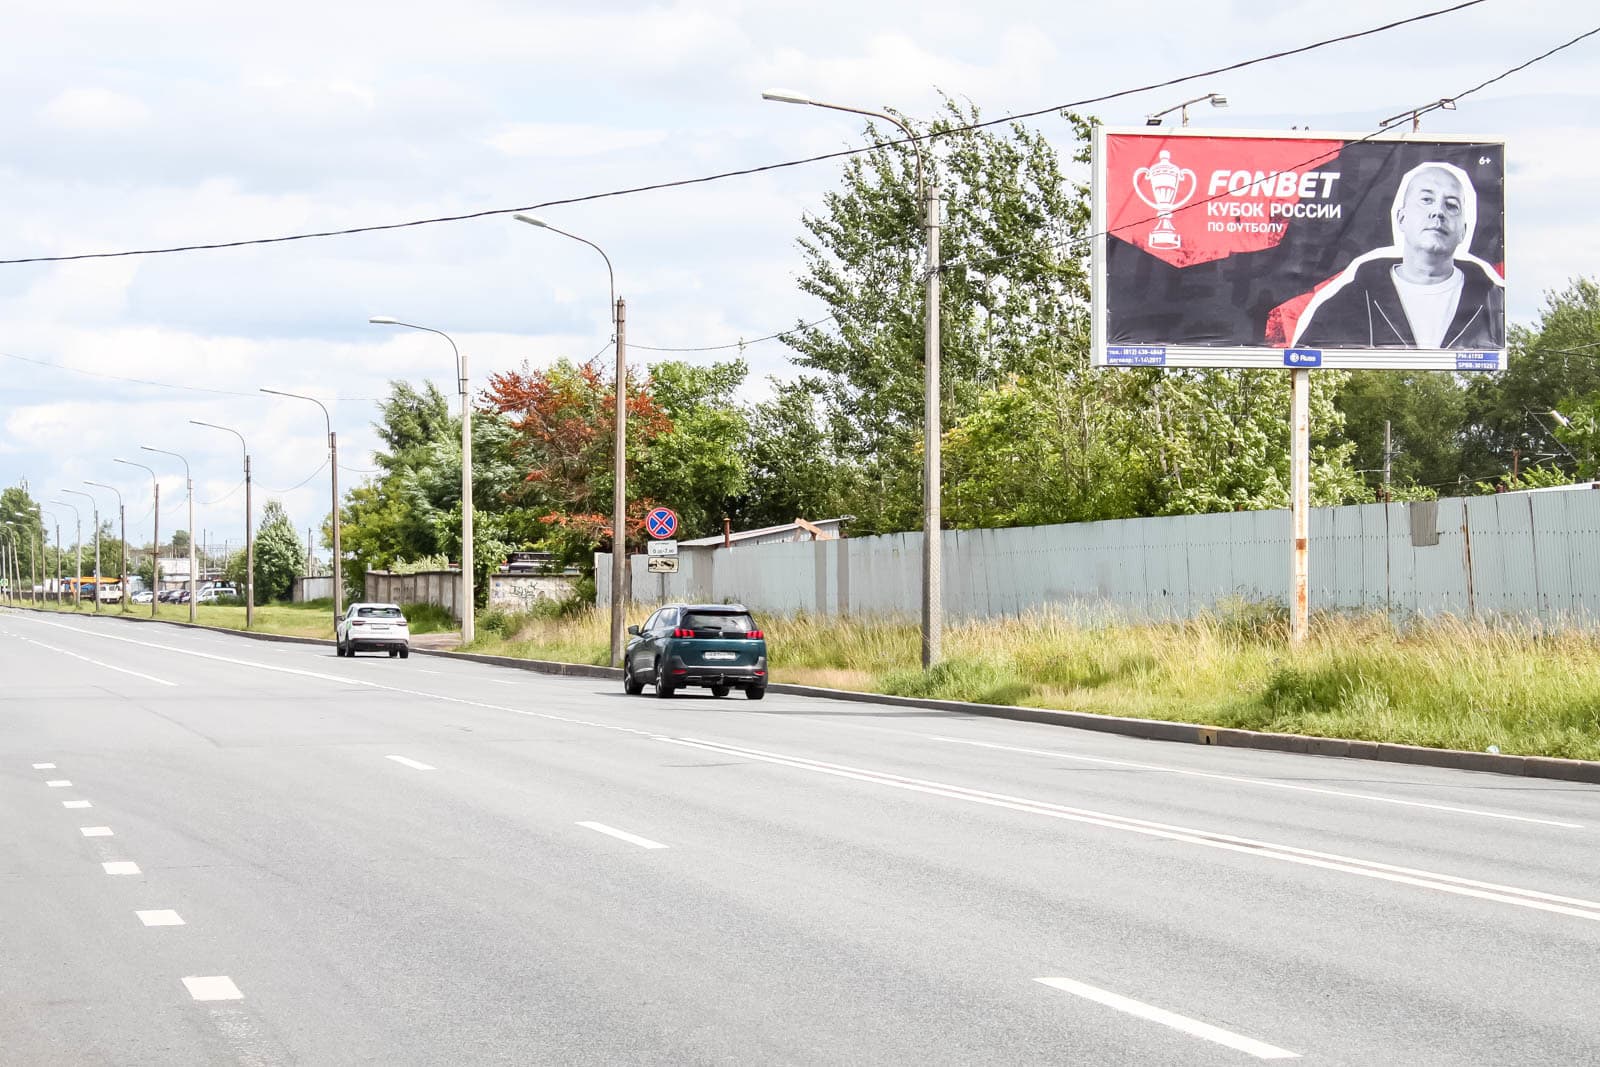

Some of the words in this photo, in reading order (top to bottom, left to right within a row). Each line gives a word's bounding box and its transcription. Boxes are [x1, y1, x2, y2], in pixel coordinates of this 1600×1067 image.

[1478, 156, 1491, 165] 6+
[1207, 169, 1341, 199] FONBET
[1207, 201, 1265, 217] КУБОК
[1270, 203, 1342, 219] РОССИИ
[1207, 221, 1224, 233] ПО
[1226, 221, 1283, 233] ФУТБОЛУ
